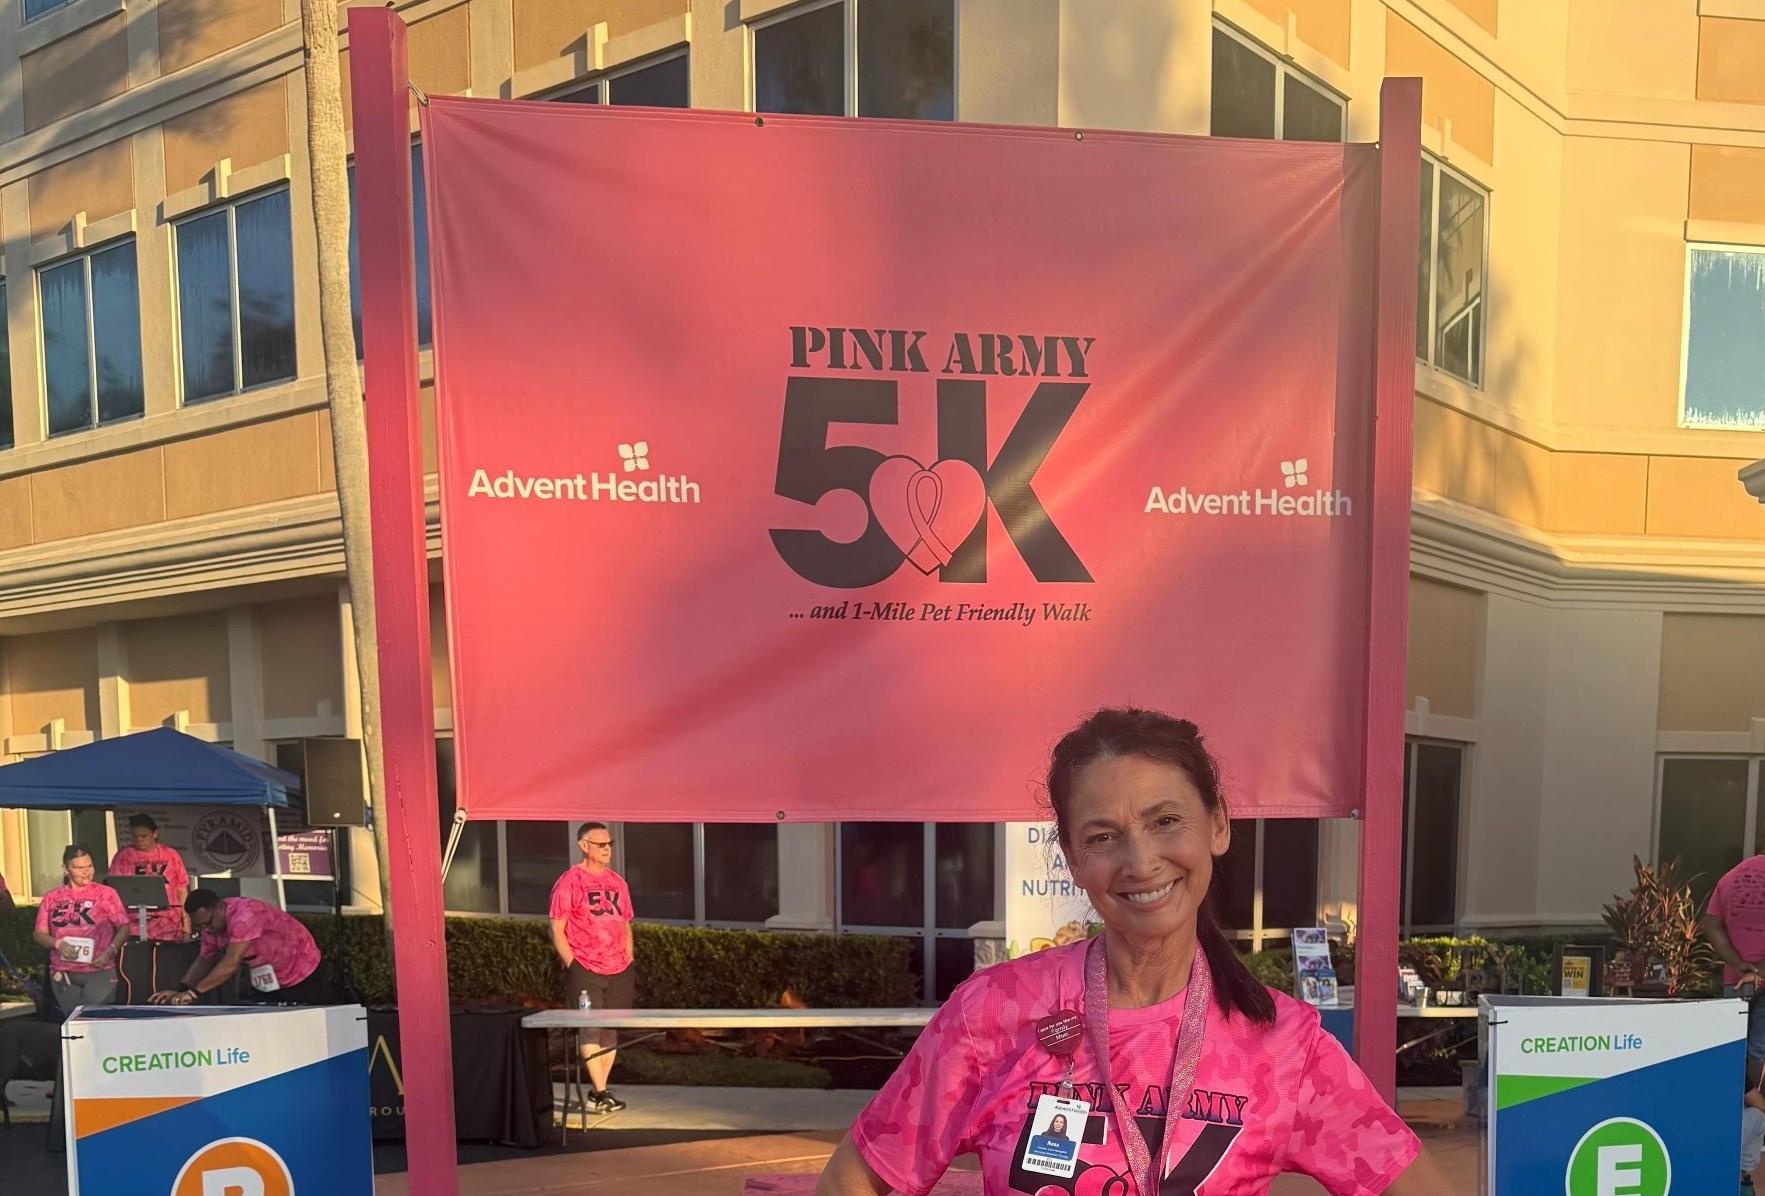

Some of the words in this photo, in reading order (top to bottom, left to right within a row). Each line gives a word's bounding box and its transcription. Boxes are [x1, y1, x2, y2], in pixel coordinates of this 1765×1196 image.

[789, 326, 929, 372] PINK
[942, 332, 1096, 378] ARMY
[467, 469, 700, 503] AdventHealth
[768, 376, 1096, 589] 5K
[1144, 486, 1352, 516] AdventHealth
[810, 602, 848, 619] and
[852, 602, 916, 621] 1-Mile
[919, 603, 953, 621] Pet
[955, 603, 1036, 626] Friendly
[1042, 604, 1091, 622] Walk
[51, 899, 97, 928] 5K
[587, 889, 623, 917] 5K
[1563, 969, 1584, 979] WIN
[1520, 1035, 1611, 1054] CREATION
[1613, 1033, 1643, 1050] Life
[102, 1049, 212, 1074] CREATION
[216, 1047, 250, 1066] Life
[369, 1106, 406, 1117] ROU
